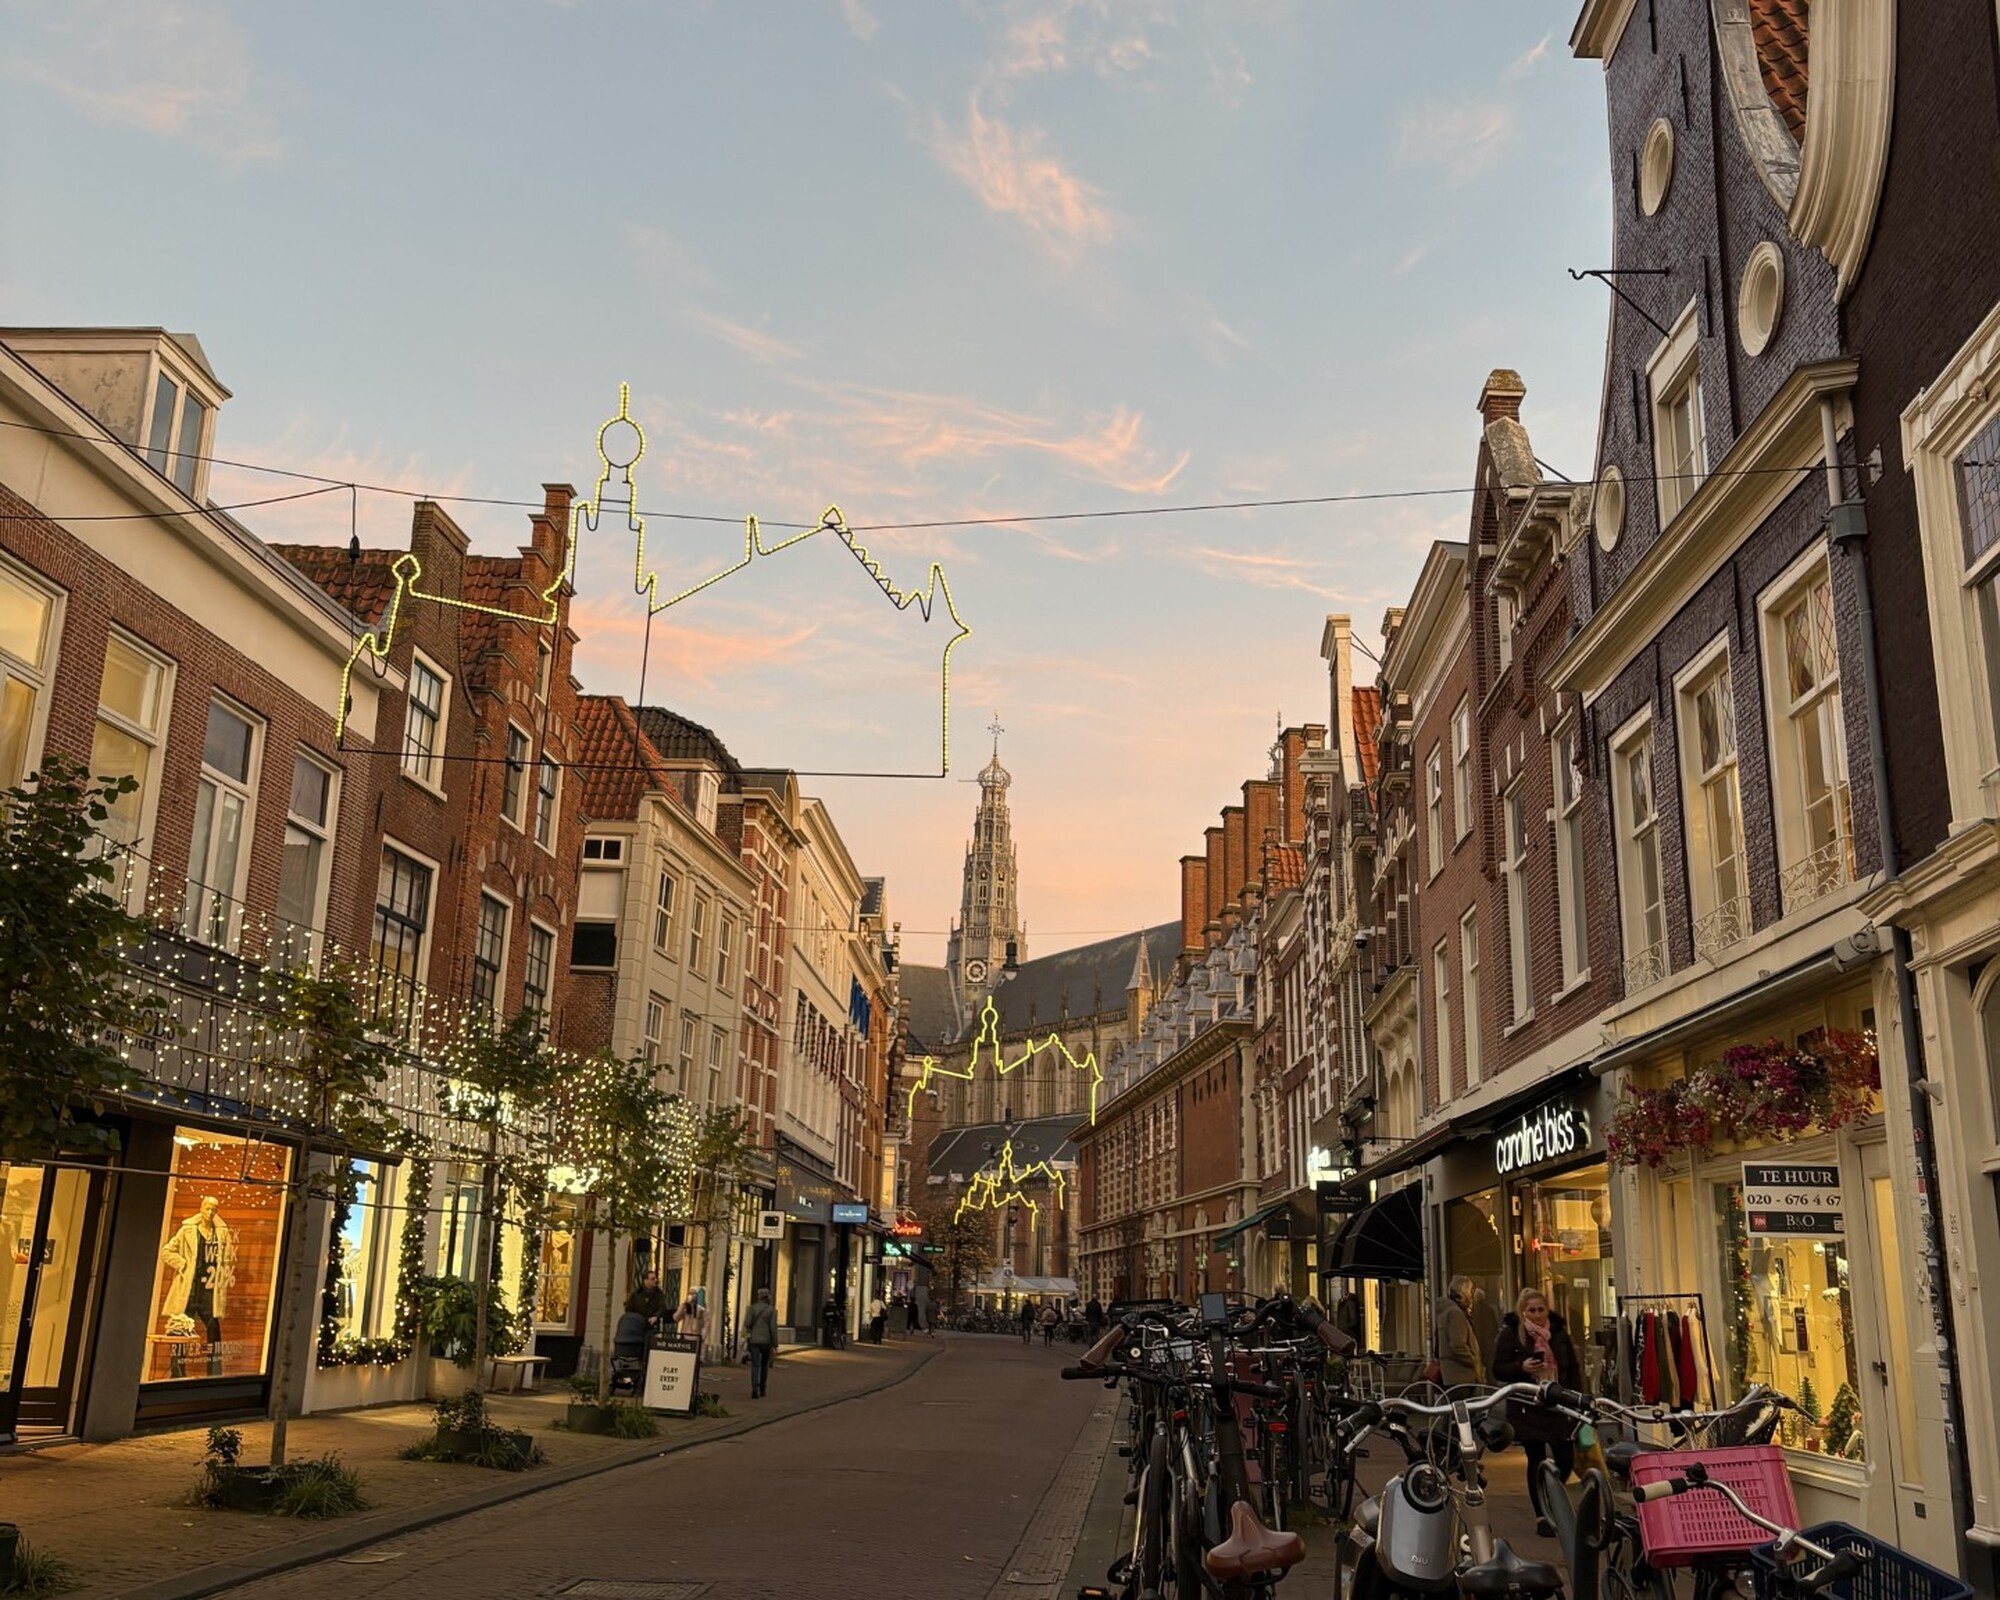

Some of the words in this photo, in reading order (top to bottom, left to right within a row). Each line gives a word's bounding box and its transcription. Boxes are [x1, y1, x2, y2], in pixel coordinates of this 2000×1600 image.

[1496, 1116, 1544, 1174] caroline
[1544, 1105, 1575, 1157] biss
[1759, 1170, 1782, 1183] TE
[1784, 1170, 1834, 1184] HUUR
[1747, 1194, 1772, 1205] 020
[1785, 1194, 1809, 1206] 676
